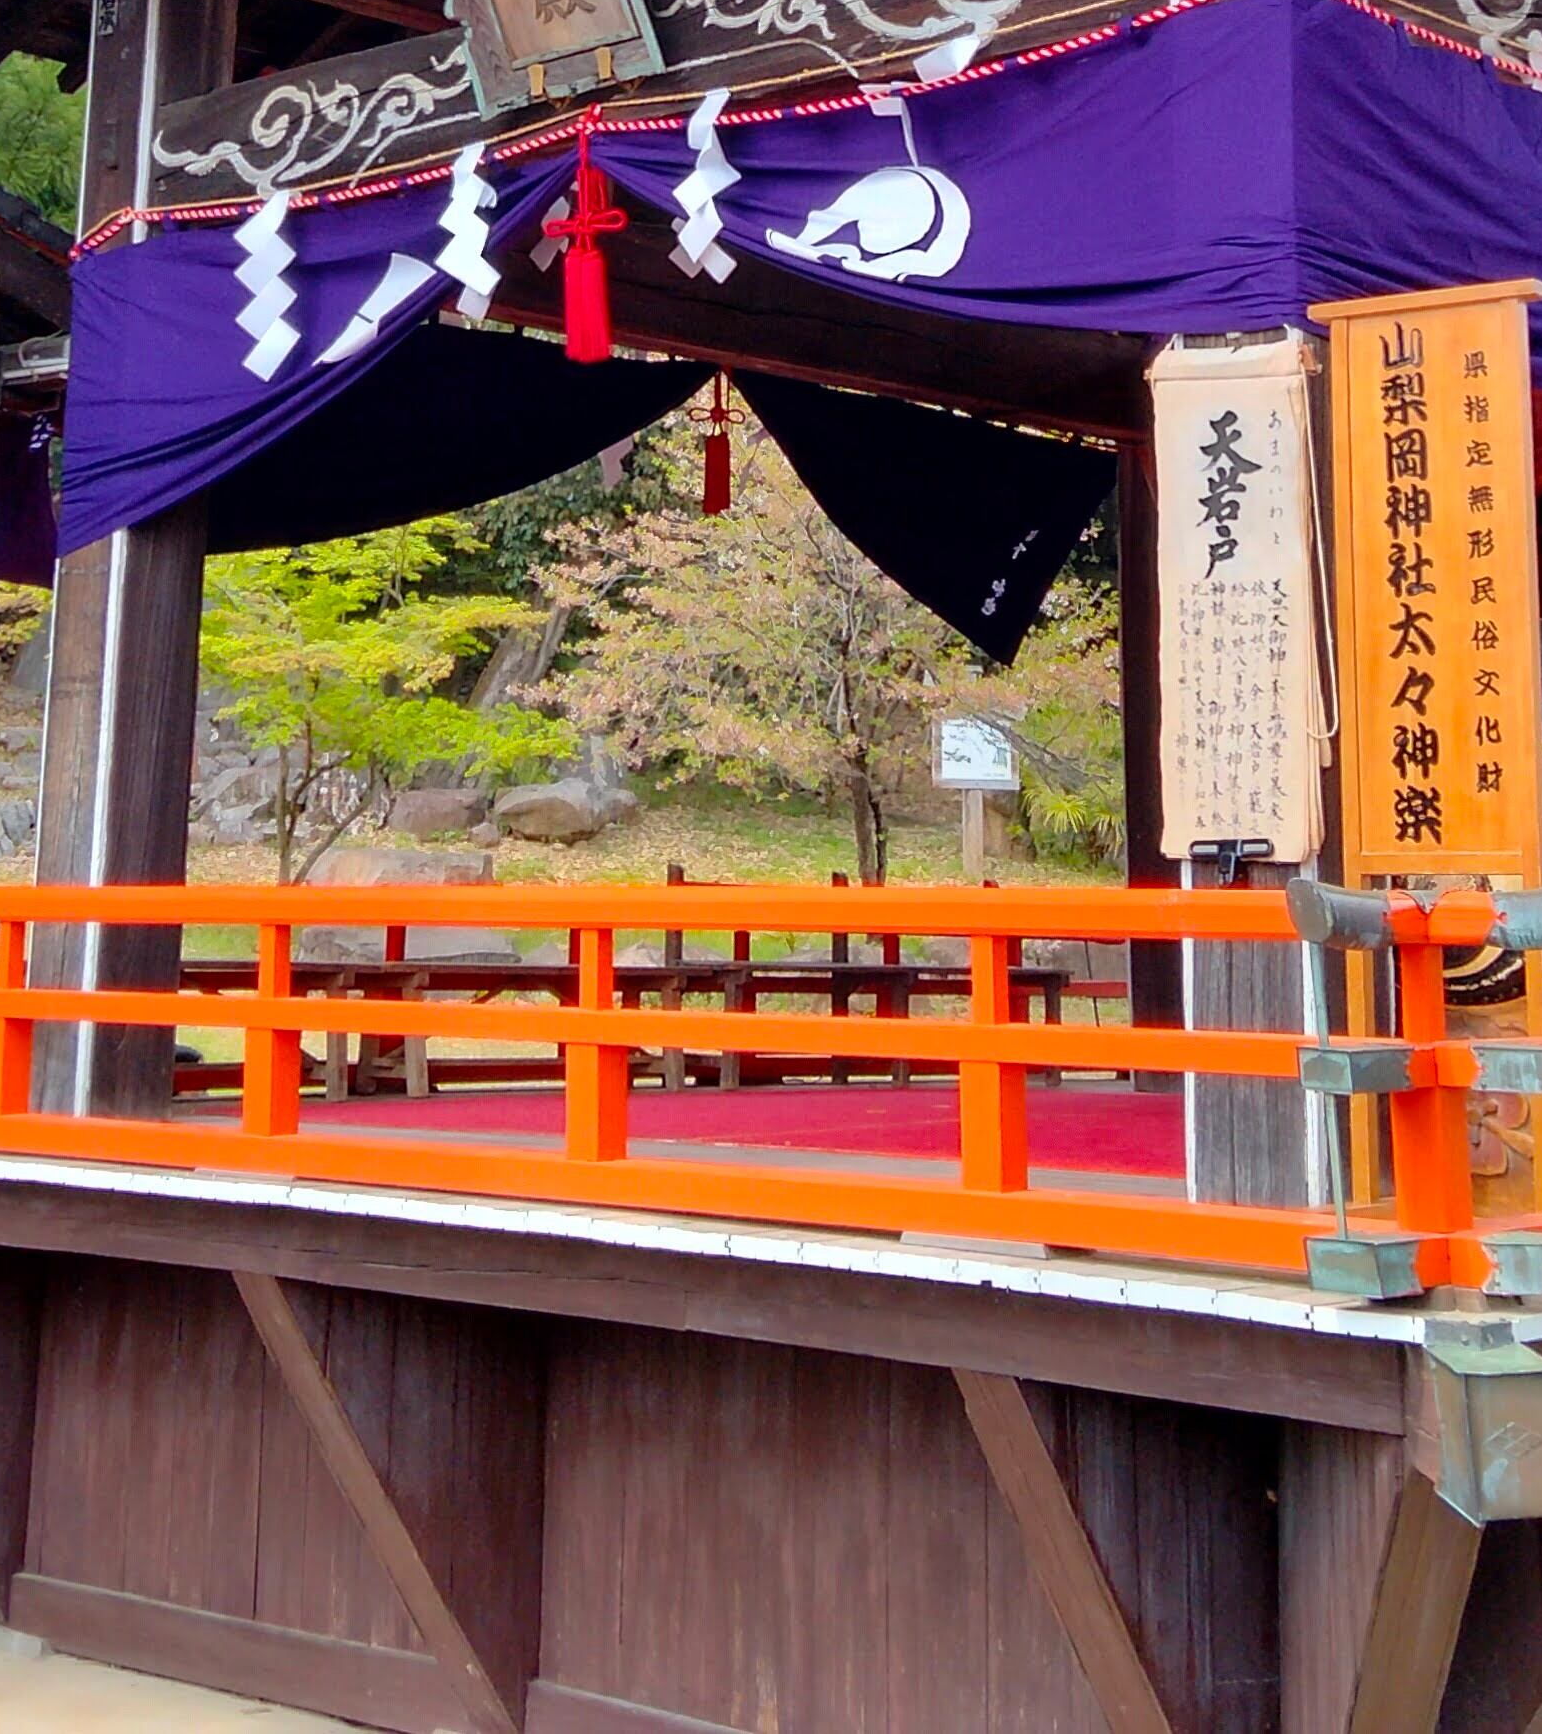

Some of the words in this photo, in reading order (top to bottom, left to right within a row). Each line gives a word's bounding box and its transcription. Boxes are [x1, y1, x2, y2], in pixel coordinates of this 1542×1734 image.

[1195, 409, 1263, 579] 天岩戸
[1380, 322, 1443, 845] 山梨岡神社太々神楽
[1462, 352, 1504, 793] 県指定無形民俗文化財
